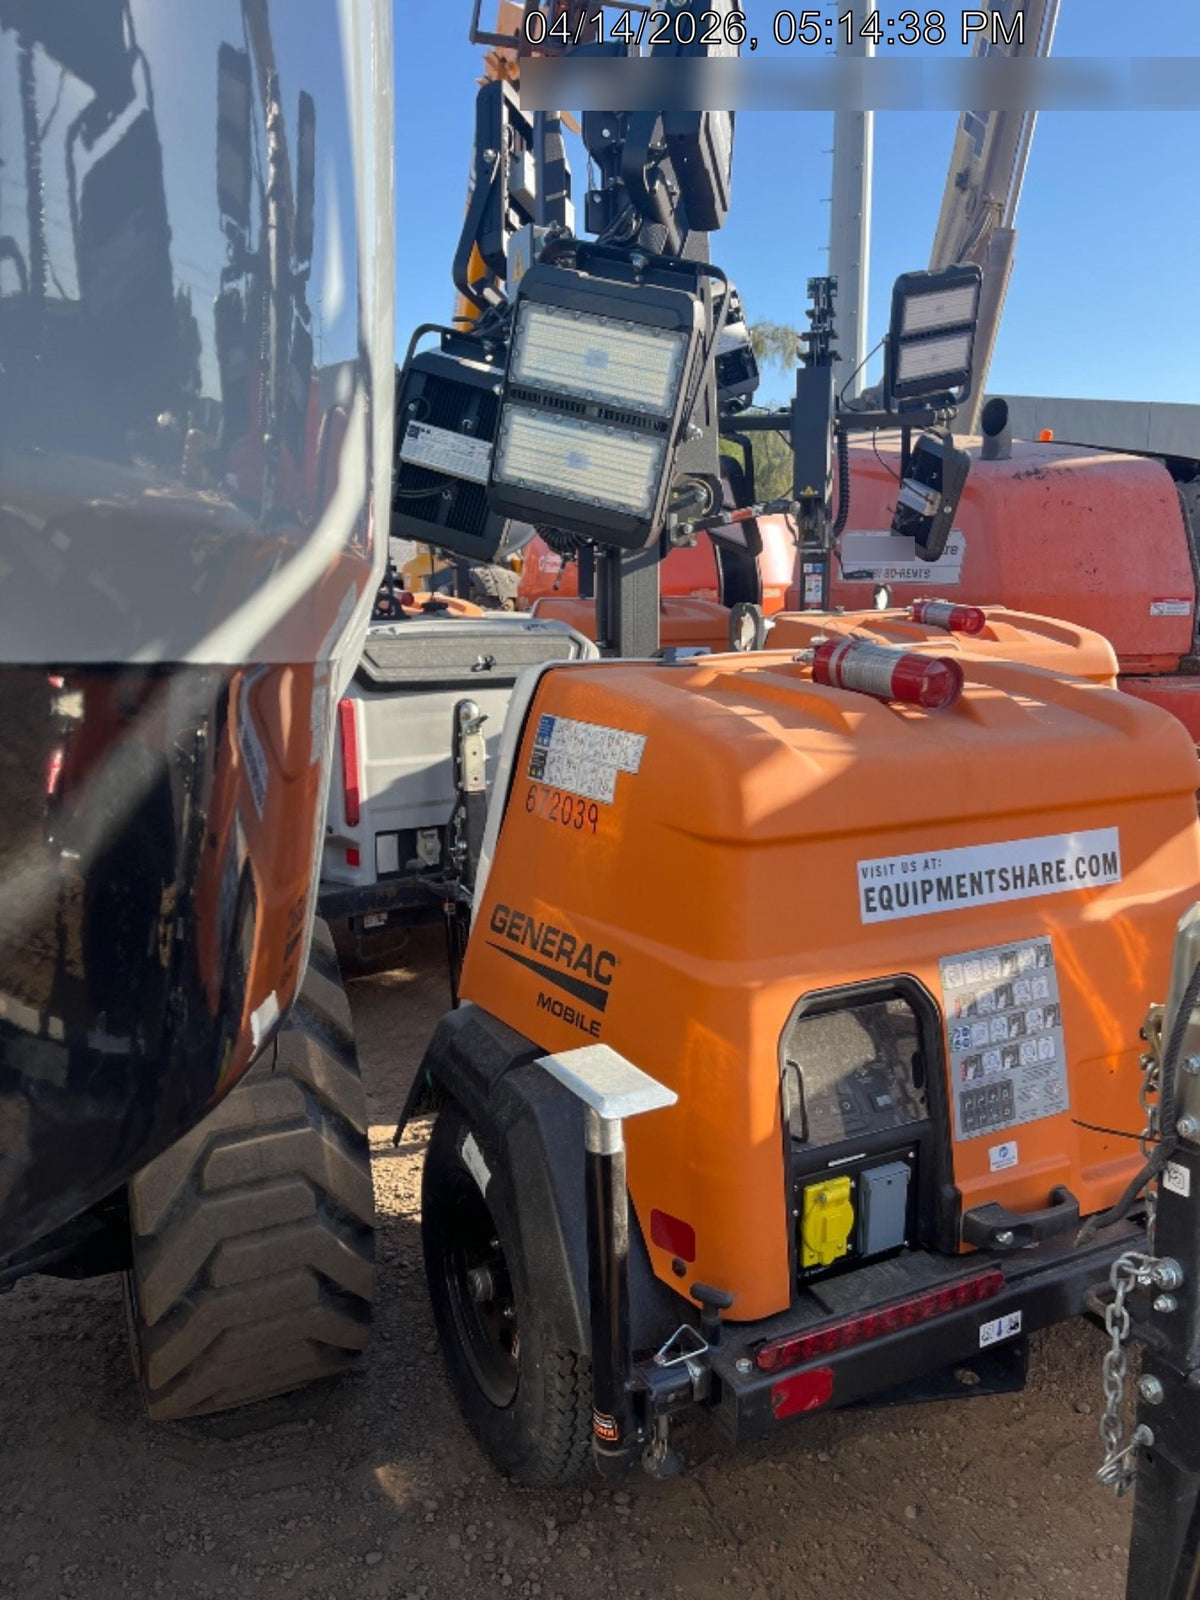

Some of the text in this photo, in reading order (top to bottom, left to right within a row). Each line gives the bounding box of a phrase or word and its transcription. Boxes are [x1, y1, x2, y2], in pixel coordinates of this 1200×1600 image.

[861, 858, 942, 879] VISIT US AT:
[863, 851, 1118, 913] EQUIPMENTSHARE.COM
[490, 903, 616, 986] GENERAC
[536, 992, 602, 1038] MOBILE
